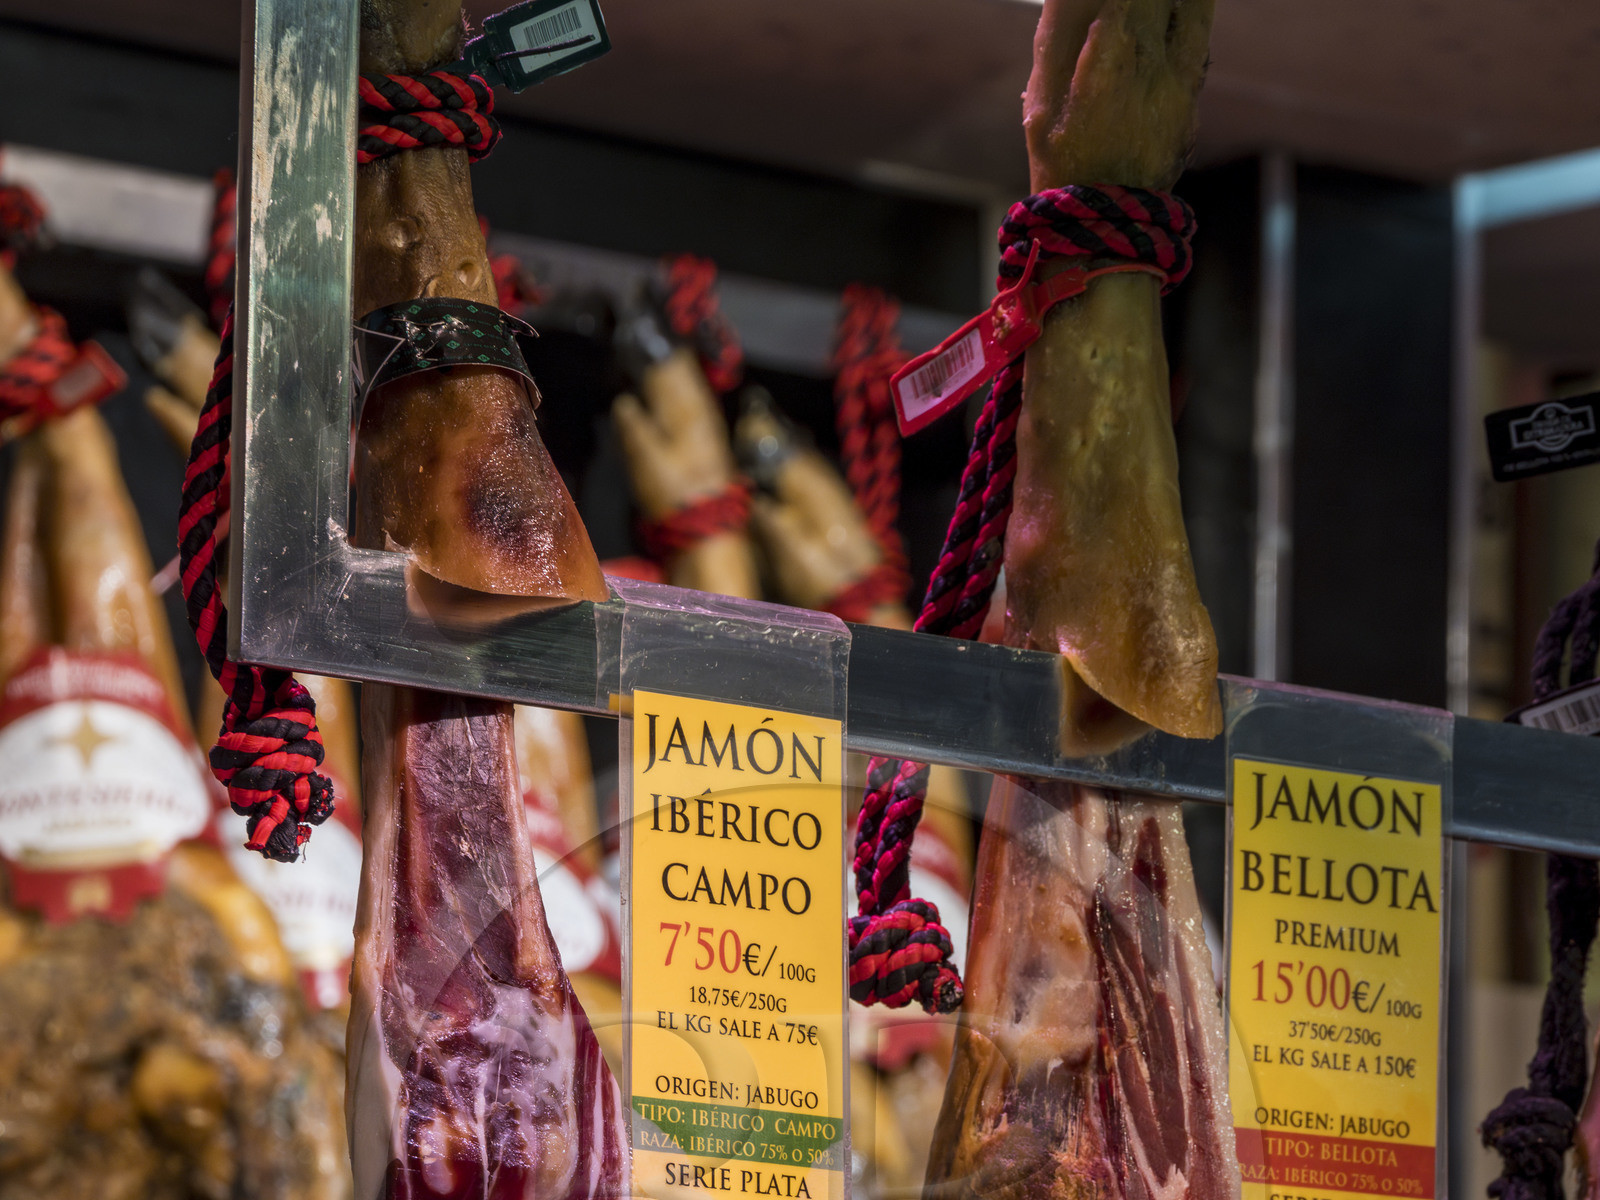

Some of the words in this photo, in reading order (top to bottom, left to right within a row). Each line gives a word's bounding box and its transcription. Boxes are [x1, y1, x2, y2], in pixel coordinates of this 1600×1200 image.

[643, 712, 826, 782] JAMÓN
[650, 788, 822, 850] IBÉRICO
[1249, 771, 1425, 838] JAMÓN
[661, 863, 812, 915] CAMPO
[1240, 849, 1438, 913] BELLOTA
[1275, 919, 1401, 957] PREMIUM
[689, 985, 787, 1013] 18,75€/250G
[657, 1010, 678, 1030] EL
[685, 1013, 712, 1034] KG
[719, 1018, 762, 1039] SALE
[768, 1024, 781, 1041] A
[785, 1022, 818, 1045] 75€
[1253, 1045, 1273, 1063] EL
[1279, 1047, 1304, 1067] KG
[1311, 1051, 1351, 1071] SALE
[1357, 1057, 1369, 1073] A
[1375, 1055, 1417, 1078] 150€
[655, 1075, 740, 1100] ORIGEN:
[744, 1084, 819, 1109] JABUGO
[637, 1103, 686, 1124] TIPO:
[691, 1106, 765, 1132] IBÉRICO
[774, 1118, 836, 1140] CAMPO
[1254, 1107, 1334, 1130] ORIGEN:
[1339, 1115, 1411, 1138] JABUGO
[640, 1130, 684, 1150] RAZA:
[690, 1133, 756, 1157] IBÉRICO
[760, 1143, 788, 1161] 75%
[807, 1148, 834, 1166] 50%
[1264, 1137, 1314, 1158] TIPO:
[1321, 1143, 1398, 1167] BELLOTA
[665, 1162, 731, 1191] SERIE
[740, 1170, 812, 1199] PLATA
[1239, 1163, 1280, 1181] RAZA:
[1284, 1165, 1347, 1188] IBÉRICO
[1351, 1173, 1378, 1190] 75%
[1396, 1177, 1423, 1195] 50%
